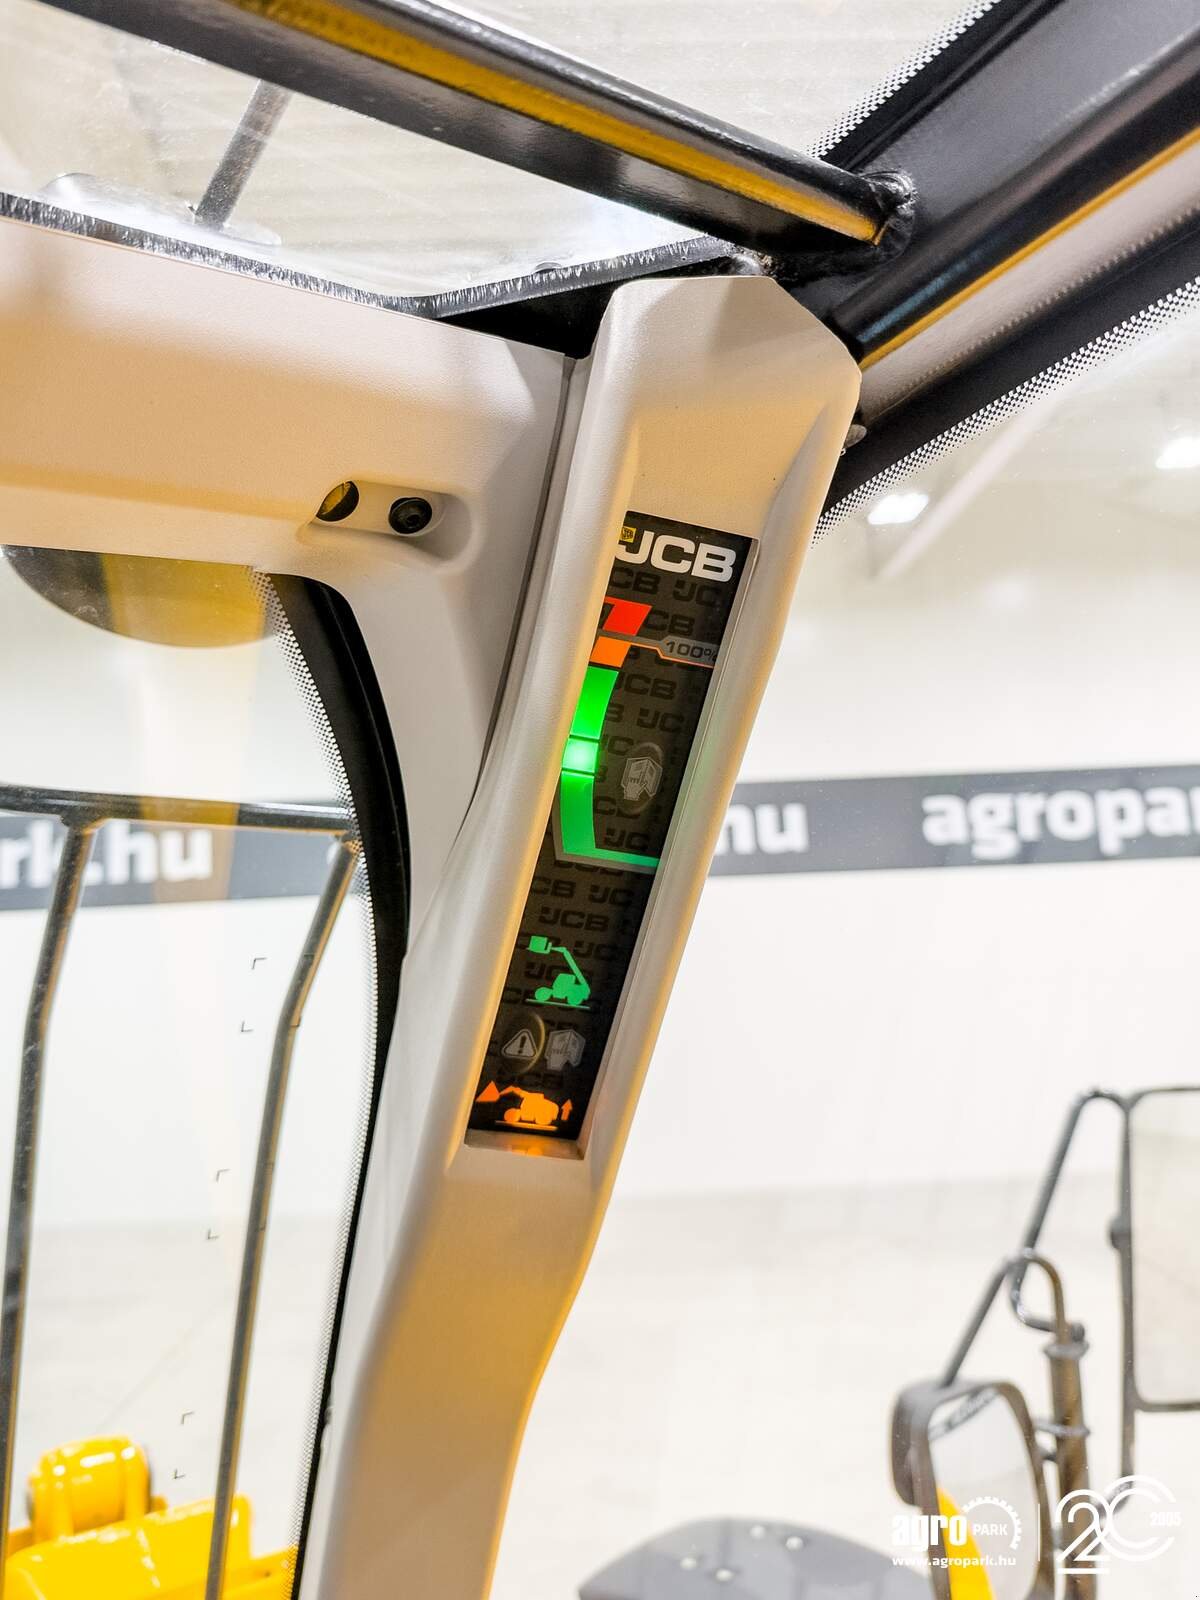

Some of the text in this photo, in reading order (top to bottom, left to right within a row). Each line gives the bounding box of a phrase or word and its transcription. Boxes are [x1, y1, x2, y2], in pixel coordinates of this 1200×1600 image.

[614, 530, 737, 583] JCB
[608, 566, 661, 595] CB
[644, 609, 696, 637] CB
